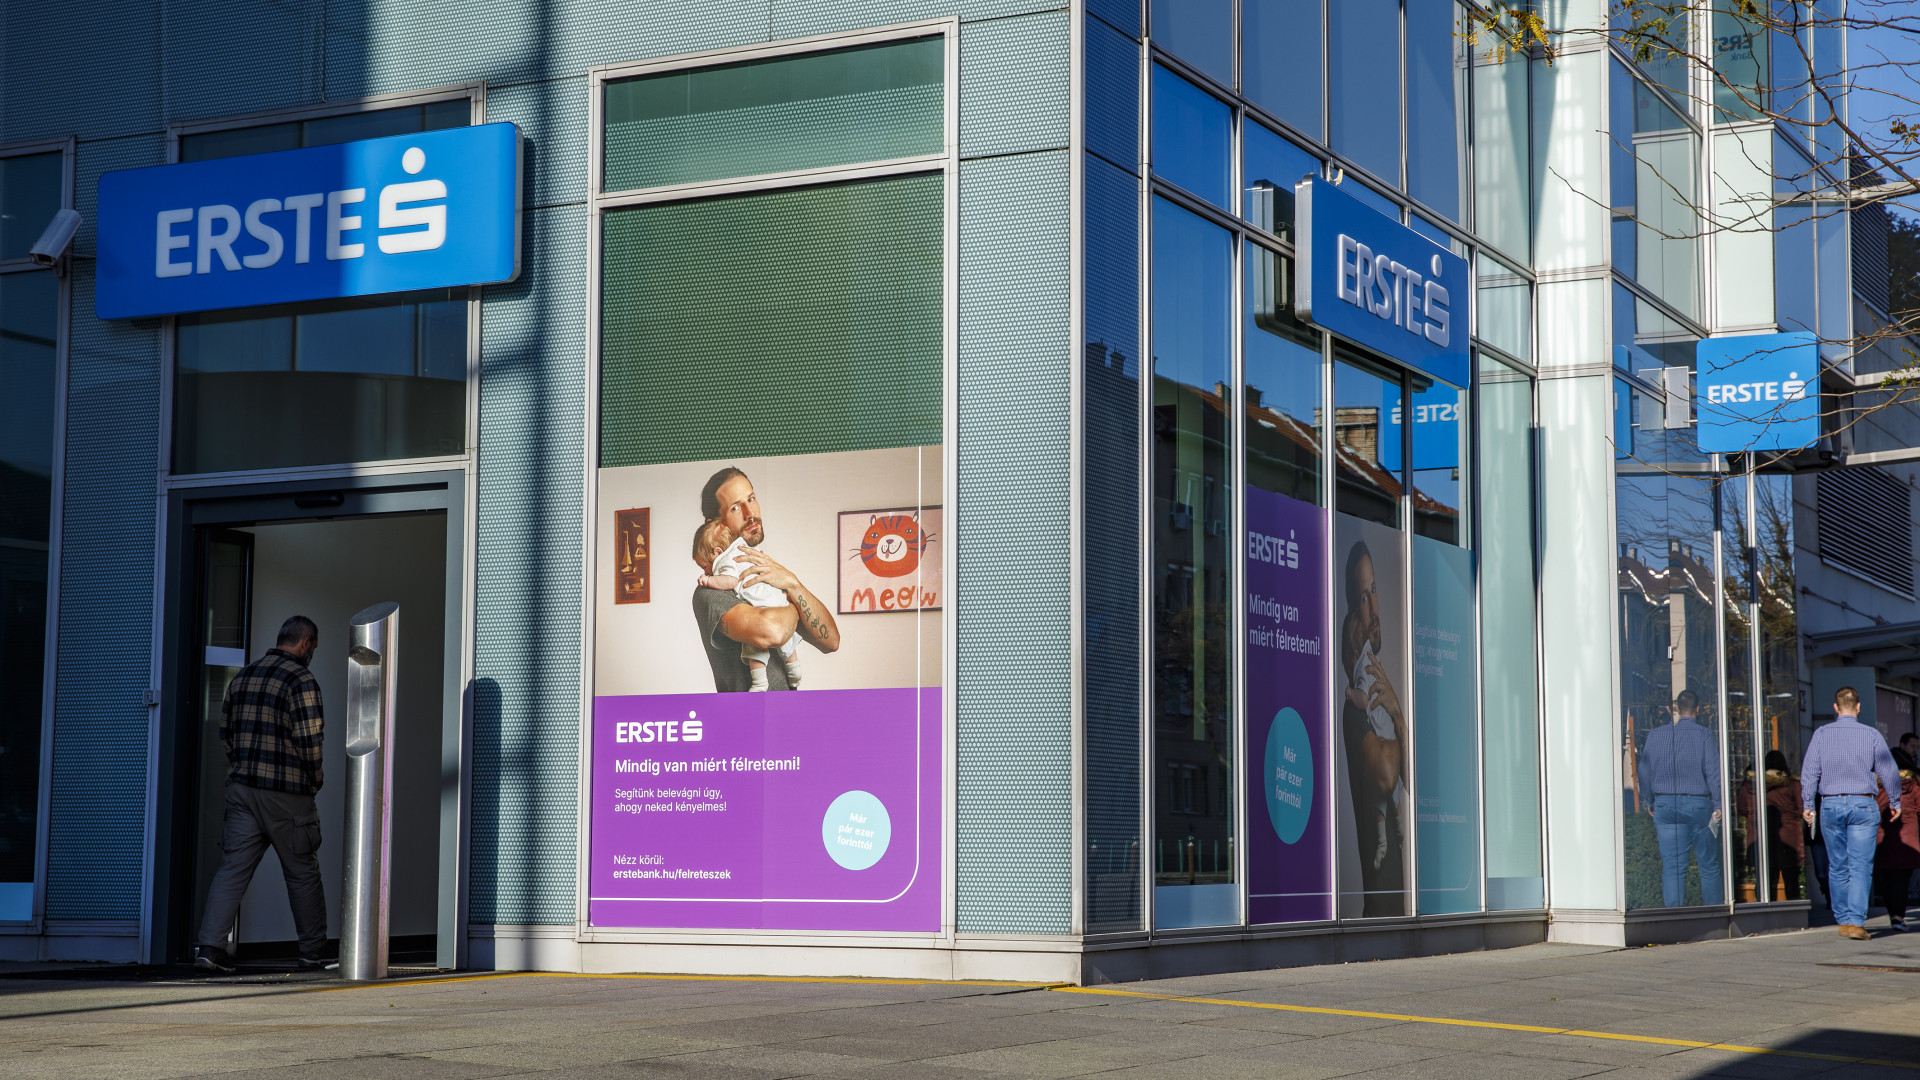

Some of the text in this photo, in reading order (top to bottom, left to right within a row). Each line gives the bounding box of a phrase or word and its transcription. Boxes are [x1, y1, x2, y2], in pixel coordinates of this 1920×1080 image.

[155, 187, 366, 278] ERSTE
[1337, 233, 1422, 336] ERSTE
[1708, 381, 1778, 404] ERSTE
[1249, 531, 1285, 566] ERSTE
[1249, 593, 1299, 624] Mindig van
[1249, 625, 1320, 655] miért félretenni!
[616, 721, 679, 743] ERSTE
[1284, 746, 1297, 764] Már
[615, 756, 800, 776] Mindig van miért félretenni!
[1276, 765, 1303, 787] pár ezer
[614, 787, 723, 800] Segítünk belevágni úgy,
[614, 801, 727, 814] ahogy neked kényelmes!
[849, 812, 867, 824] Már
[838, 823, 874, 838] pár ezer
[837, 834, 873, 851] forinttól
[613, 854, 664, 865] Nézz körül:
[613, 868, 731, 880] erstebank.hu/felreteszek
